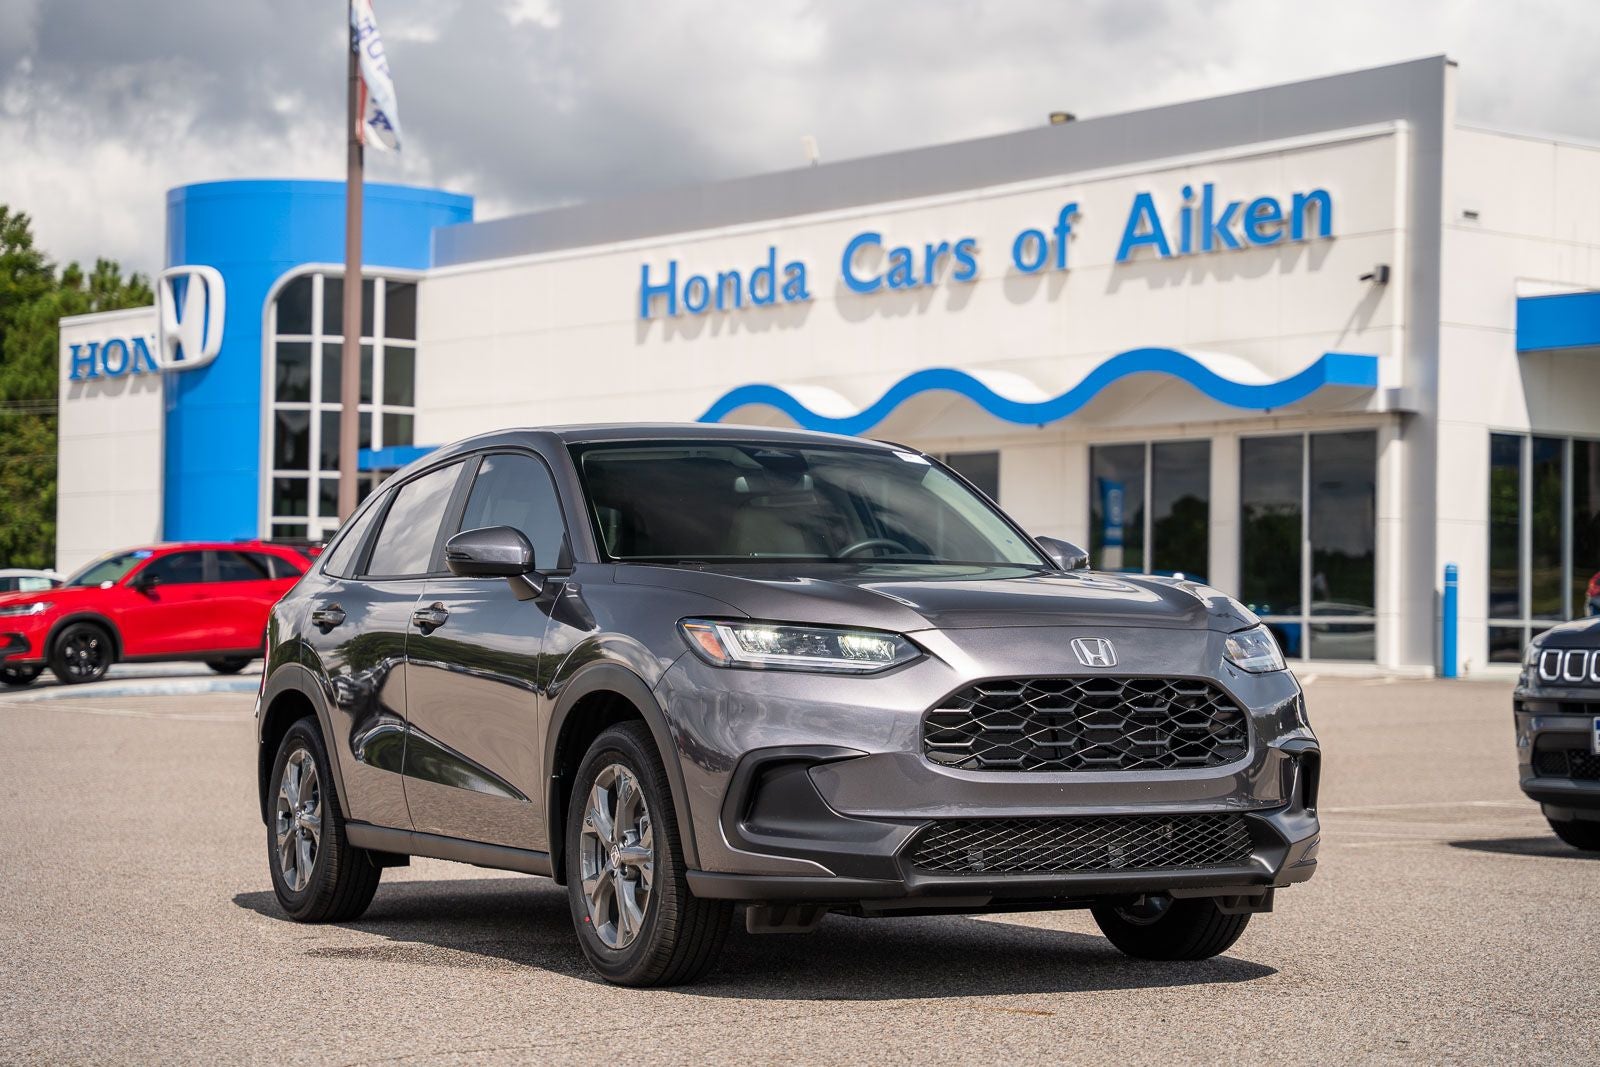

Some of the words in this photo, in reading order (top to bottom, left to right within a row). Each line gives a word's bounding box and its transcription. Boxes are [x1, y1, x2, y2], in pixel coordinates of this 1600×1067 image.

[640, 246, 810, 319] Honda
[841, 232, 977, 293] Cars
[1012, 202, 1078, 273] of
[1115, 182, 1333, 263] Aiken
